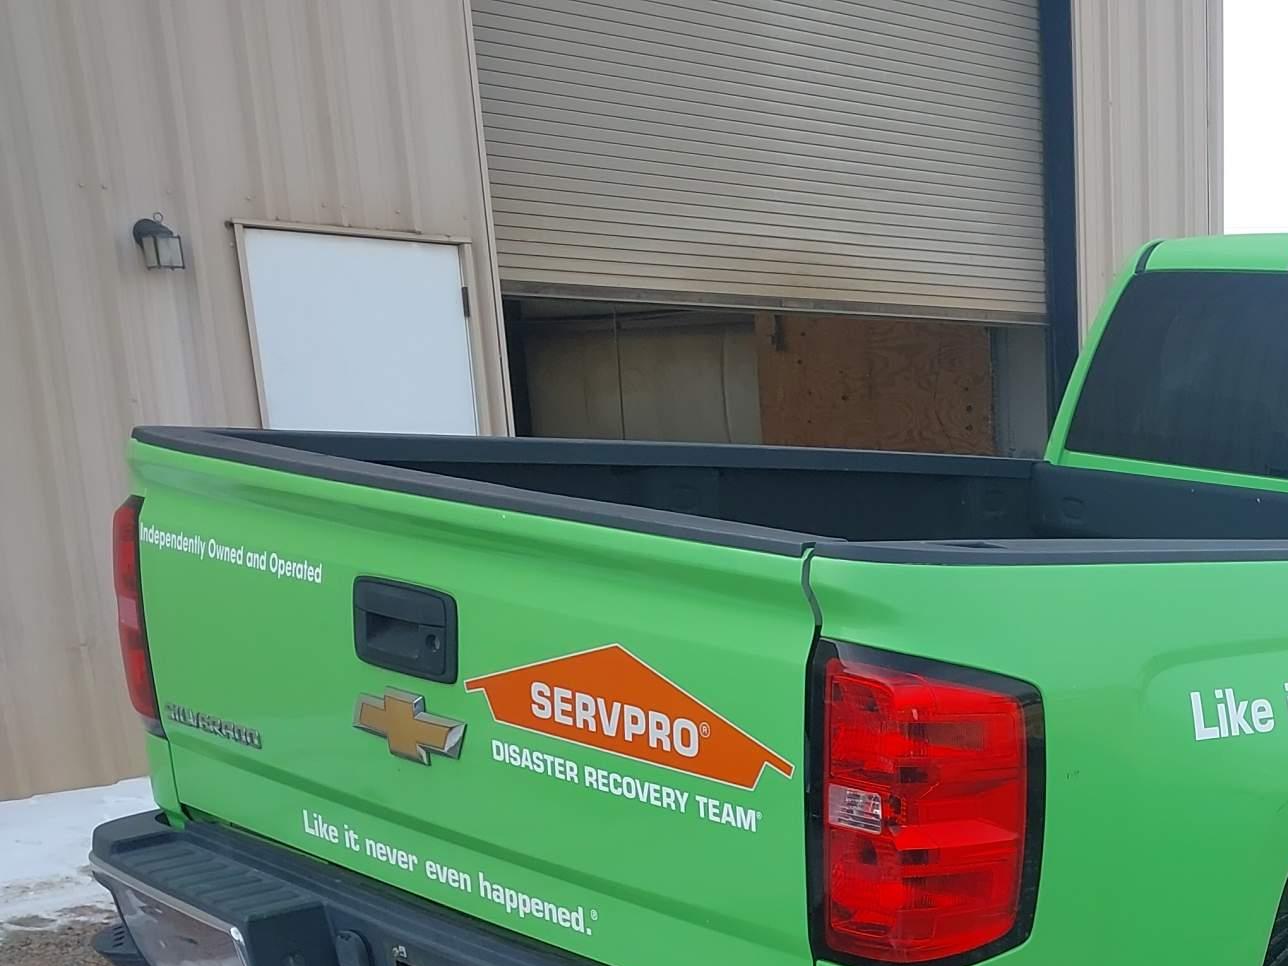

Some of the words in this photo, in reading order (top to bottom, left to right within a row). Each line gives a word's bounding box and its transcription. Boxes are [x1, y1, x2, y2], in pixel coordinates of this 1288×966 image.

[139, 522, 206, 560] Independently
[208, 539, 243, 565] Owned
[246, 552, 266, 571] and
[269, 553, 322, 584] Operated
[1189, 688, 1275, 741] Like
[491, 739, 579, 784] DISASTER
[584, 766, 689, 813] RECOVERY
[303, 809, 339, 844] Like
[344, 824, 360, 852] it
[365, 837, 418, 872] never
[425, 859, 472, 893] even
